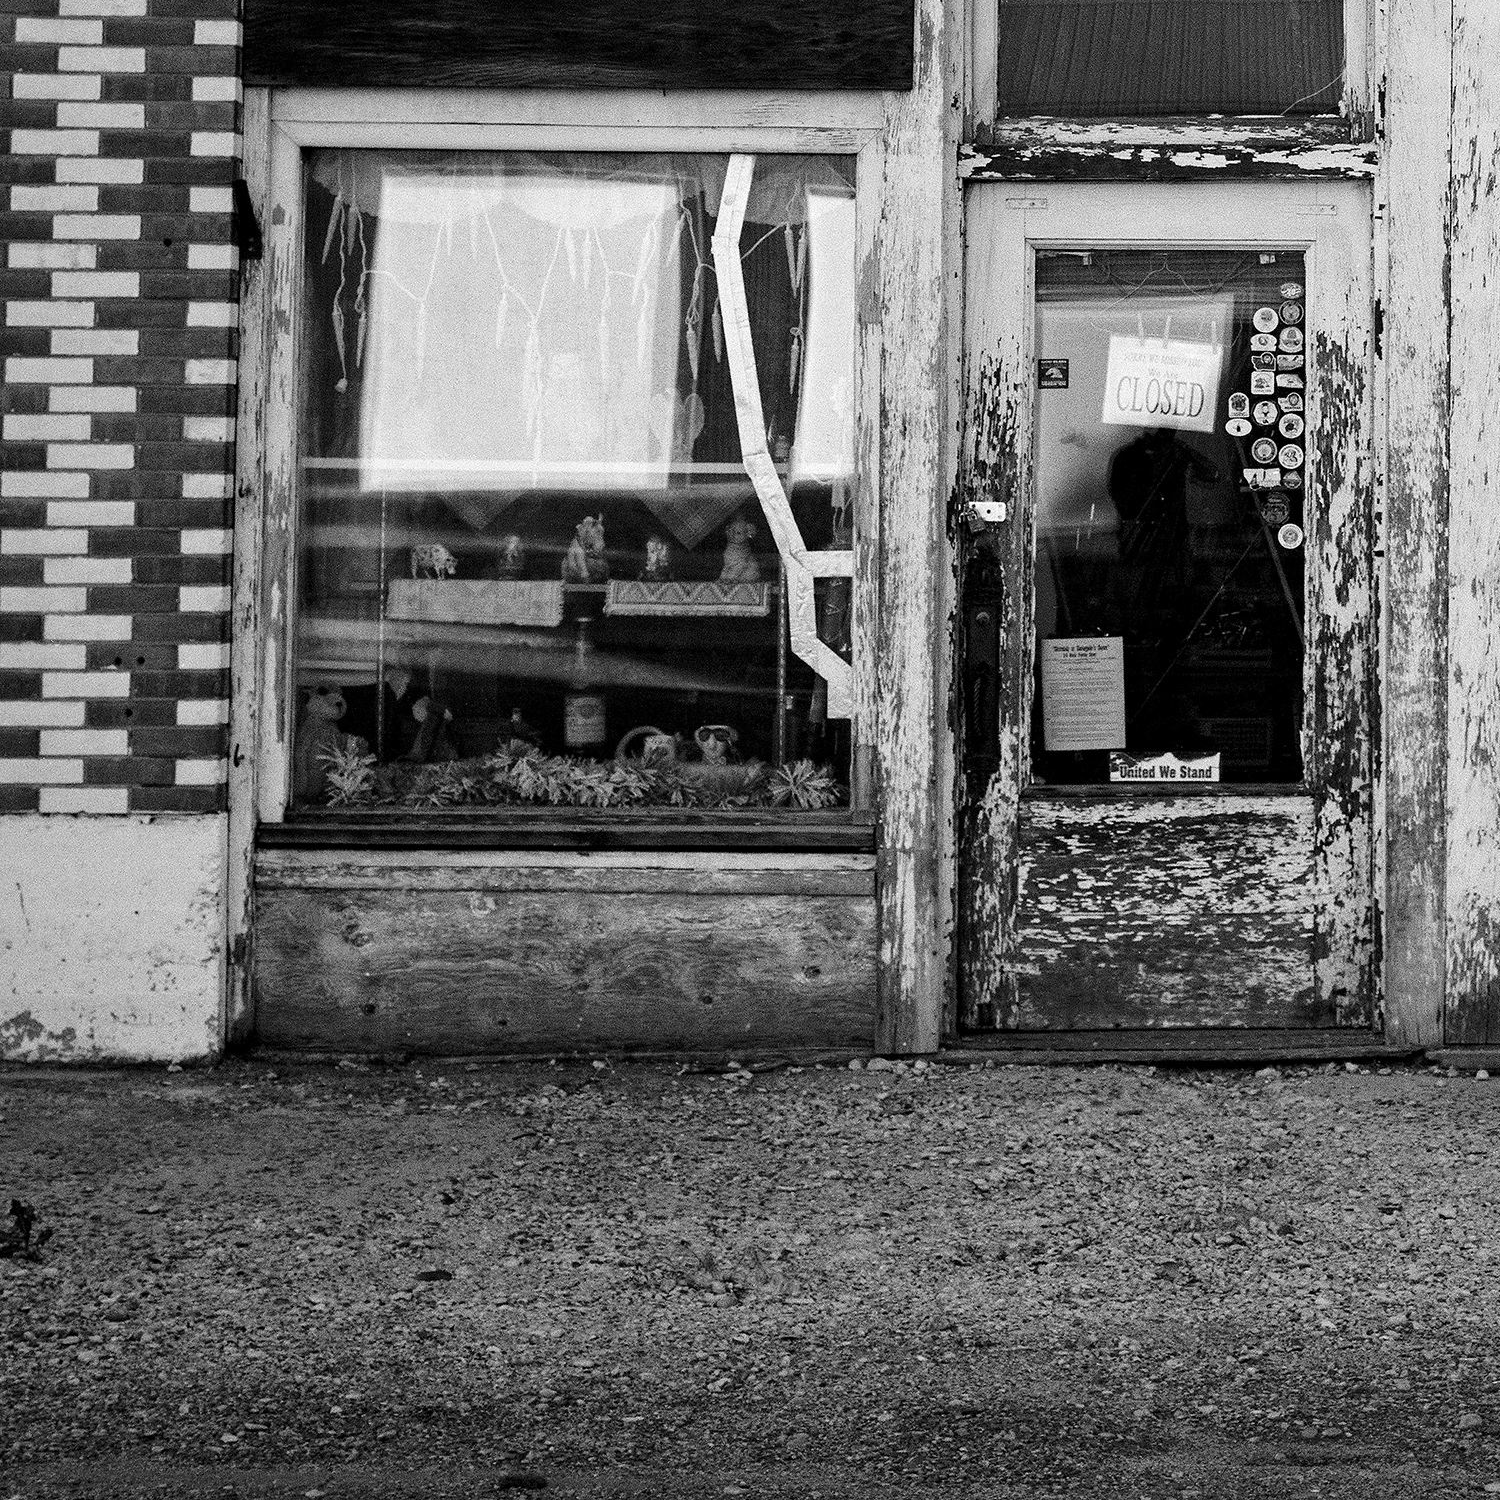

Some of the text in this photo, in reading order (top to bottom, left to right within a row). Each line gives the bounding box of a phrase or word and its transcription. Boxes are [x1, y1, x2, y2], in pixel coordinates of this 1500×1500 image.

[1116, 375, 1205, 418] CLOSED
[1120, 765, 1212, 779] United We Stand
